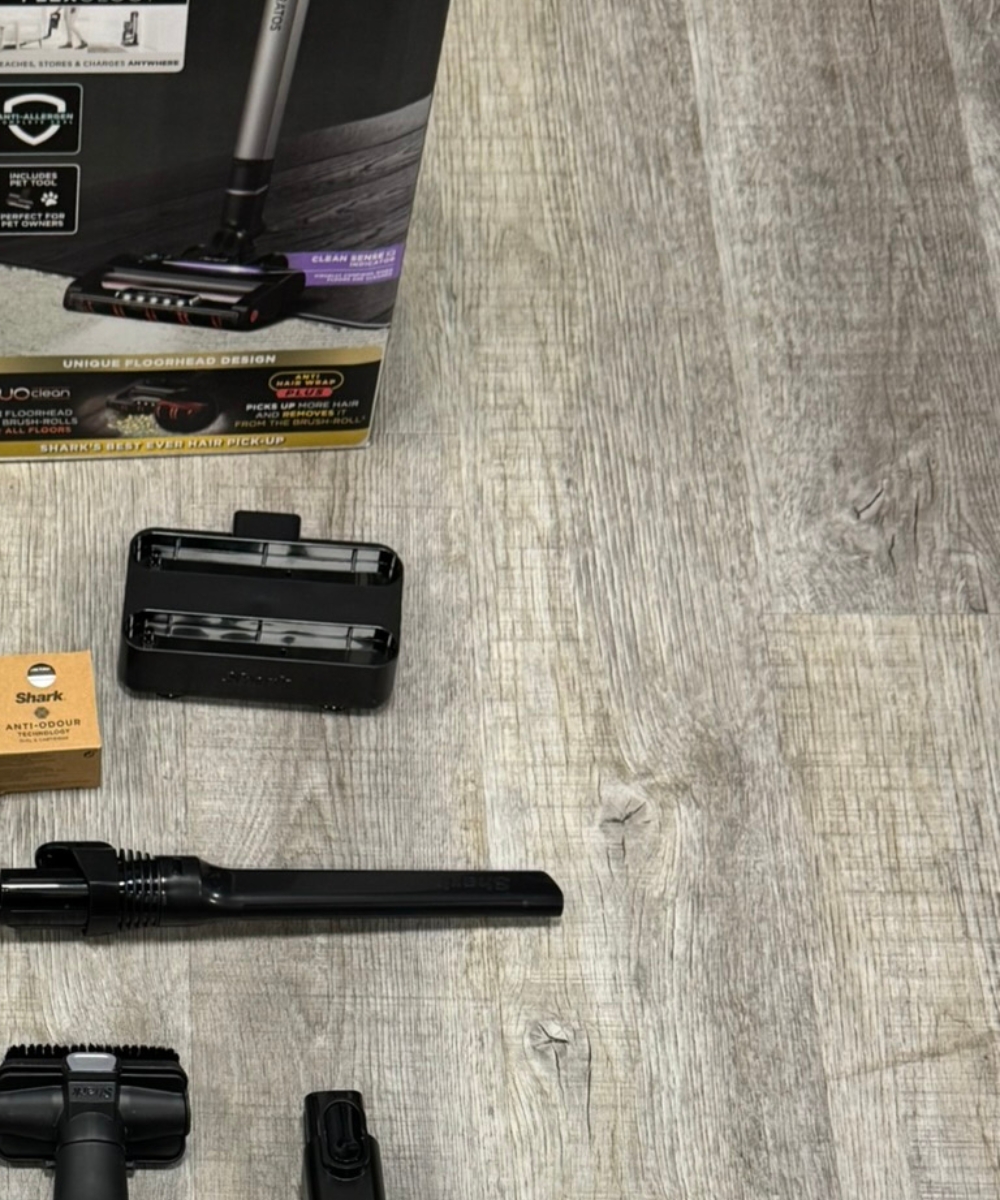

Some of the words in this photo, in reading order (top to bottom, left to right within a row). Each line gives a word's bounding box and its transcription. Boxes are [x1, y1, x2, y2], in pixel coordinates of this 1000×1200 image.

[270, 0, 286, 31] ATOS
[9, 172, 57, 180] INCLUDES
[311, 255, 347, 263] CLEAN
[351, 252, 384, 262] SENSE
[62, 359, 120, 368] UNIQUE
[125, 357, 216, 367] FLOORHEAD
[221, 355, 276, 365] DESIGN
[304, 378, 336, 386] WRAP
[285, 389, 323, 397] PLUS
[246, 403, 277, 411] PICKS
[280, 402, 295, 410] UP
[298, 401, 330, 409] MORE
[332, 400, 359, 408] HAIR
[5, 409, 73, 417] FLOORHEAD
[255, 411, 280, 419] AND
[282, 409, 335, 418] REMOVES
[2, 417, 78, 426] BRUSH-ROLLS
[234, 420, 266, 428] FROM
[269, 419, 290, 427] THE
[28, 426, 72, 434] FLOORS
[40, 443, 101, 453] SHARK'S
[106, 442, 143, 451] BEST
[147, 440, 184, 450] EVER
[188, 439, 222, 449] HAIR
[227, 437, 285, 447] PICK-UP
[15, 690, 64, 704] Shark
[5, 719, 81, 731] ANTI-ODOUR
[17, 728, 70, 738] TECHNOLOGY
